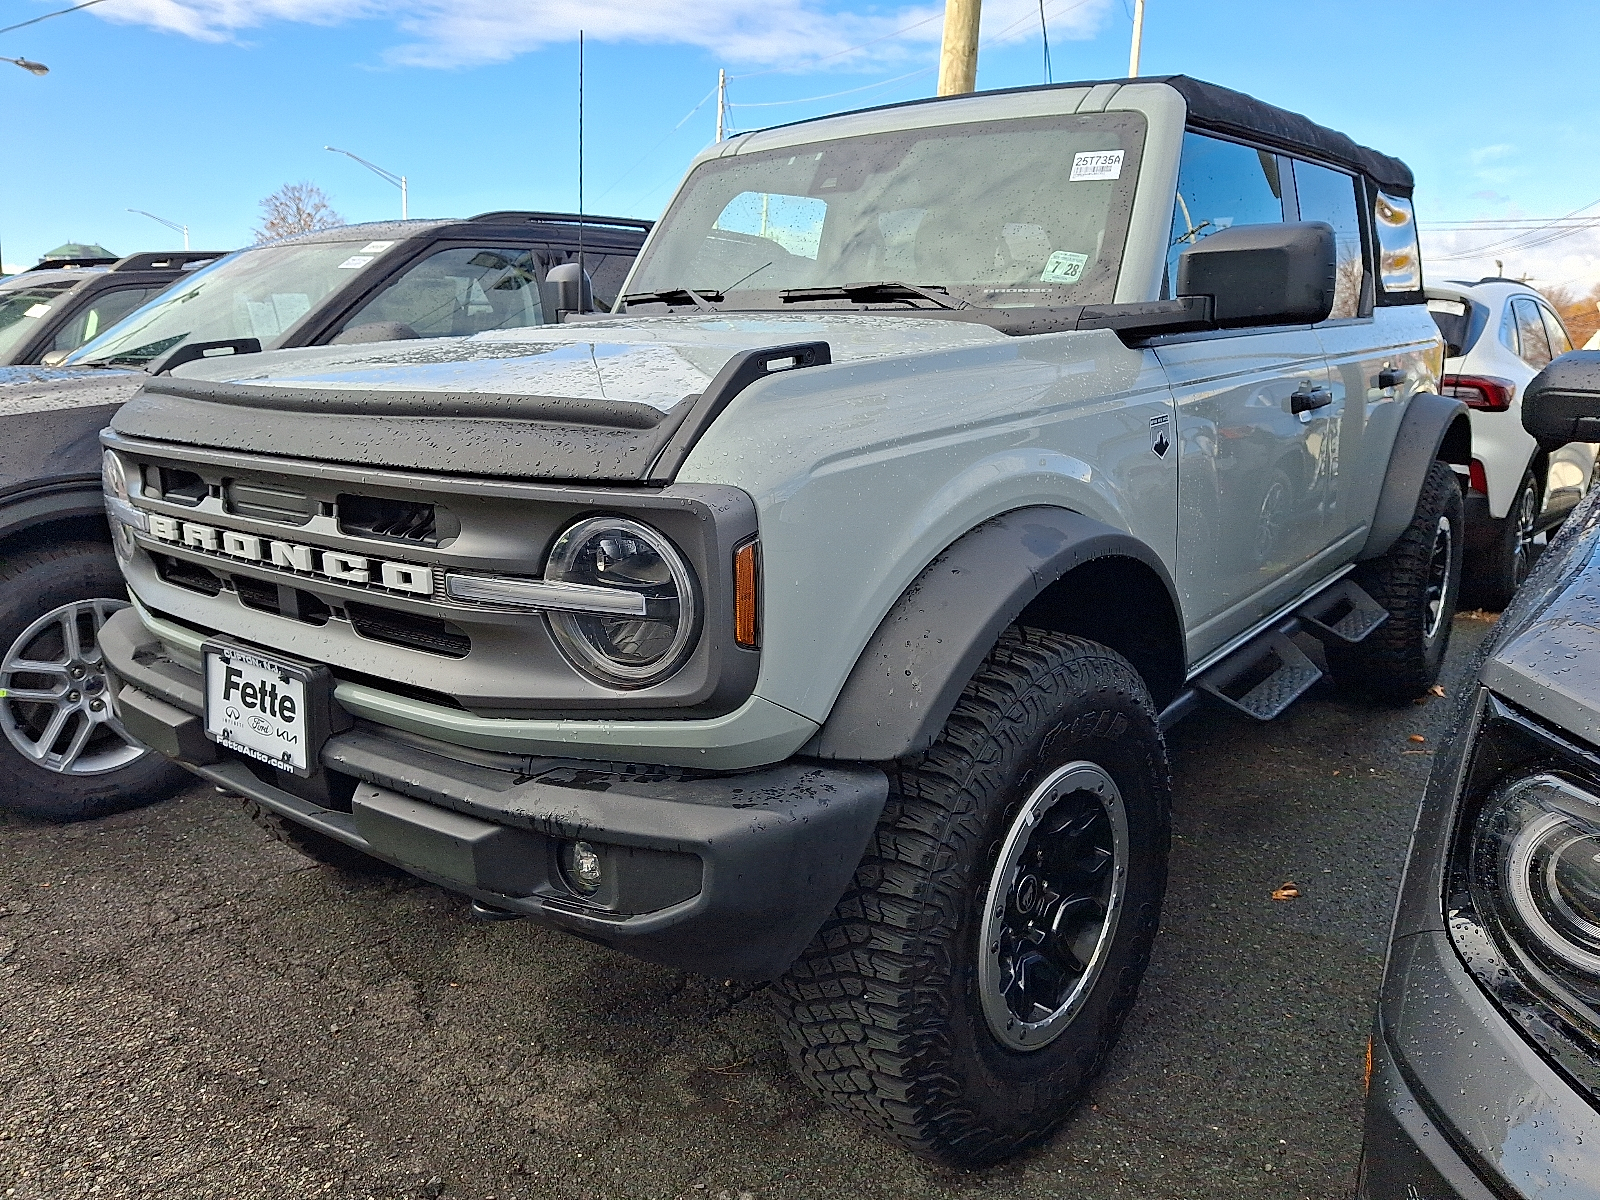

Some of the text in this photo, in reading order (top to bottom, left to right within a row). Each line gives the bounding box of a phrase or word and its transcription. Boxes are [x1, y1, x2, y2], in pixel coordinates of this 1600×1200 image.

[1075, 155, 1121, 167] 25T735A
[1051, 261, 1080, 277] 7 28
[149, 514, 434, 595] BRONCO
[222, 665, 297, 724] Fette
[250, 717, 270, 734] Ford
